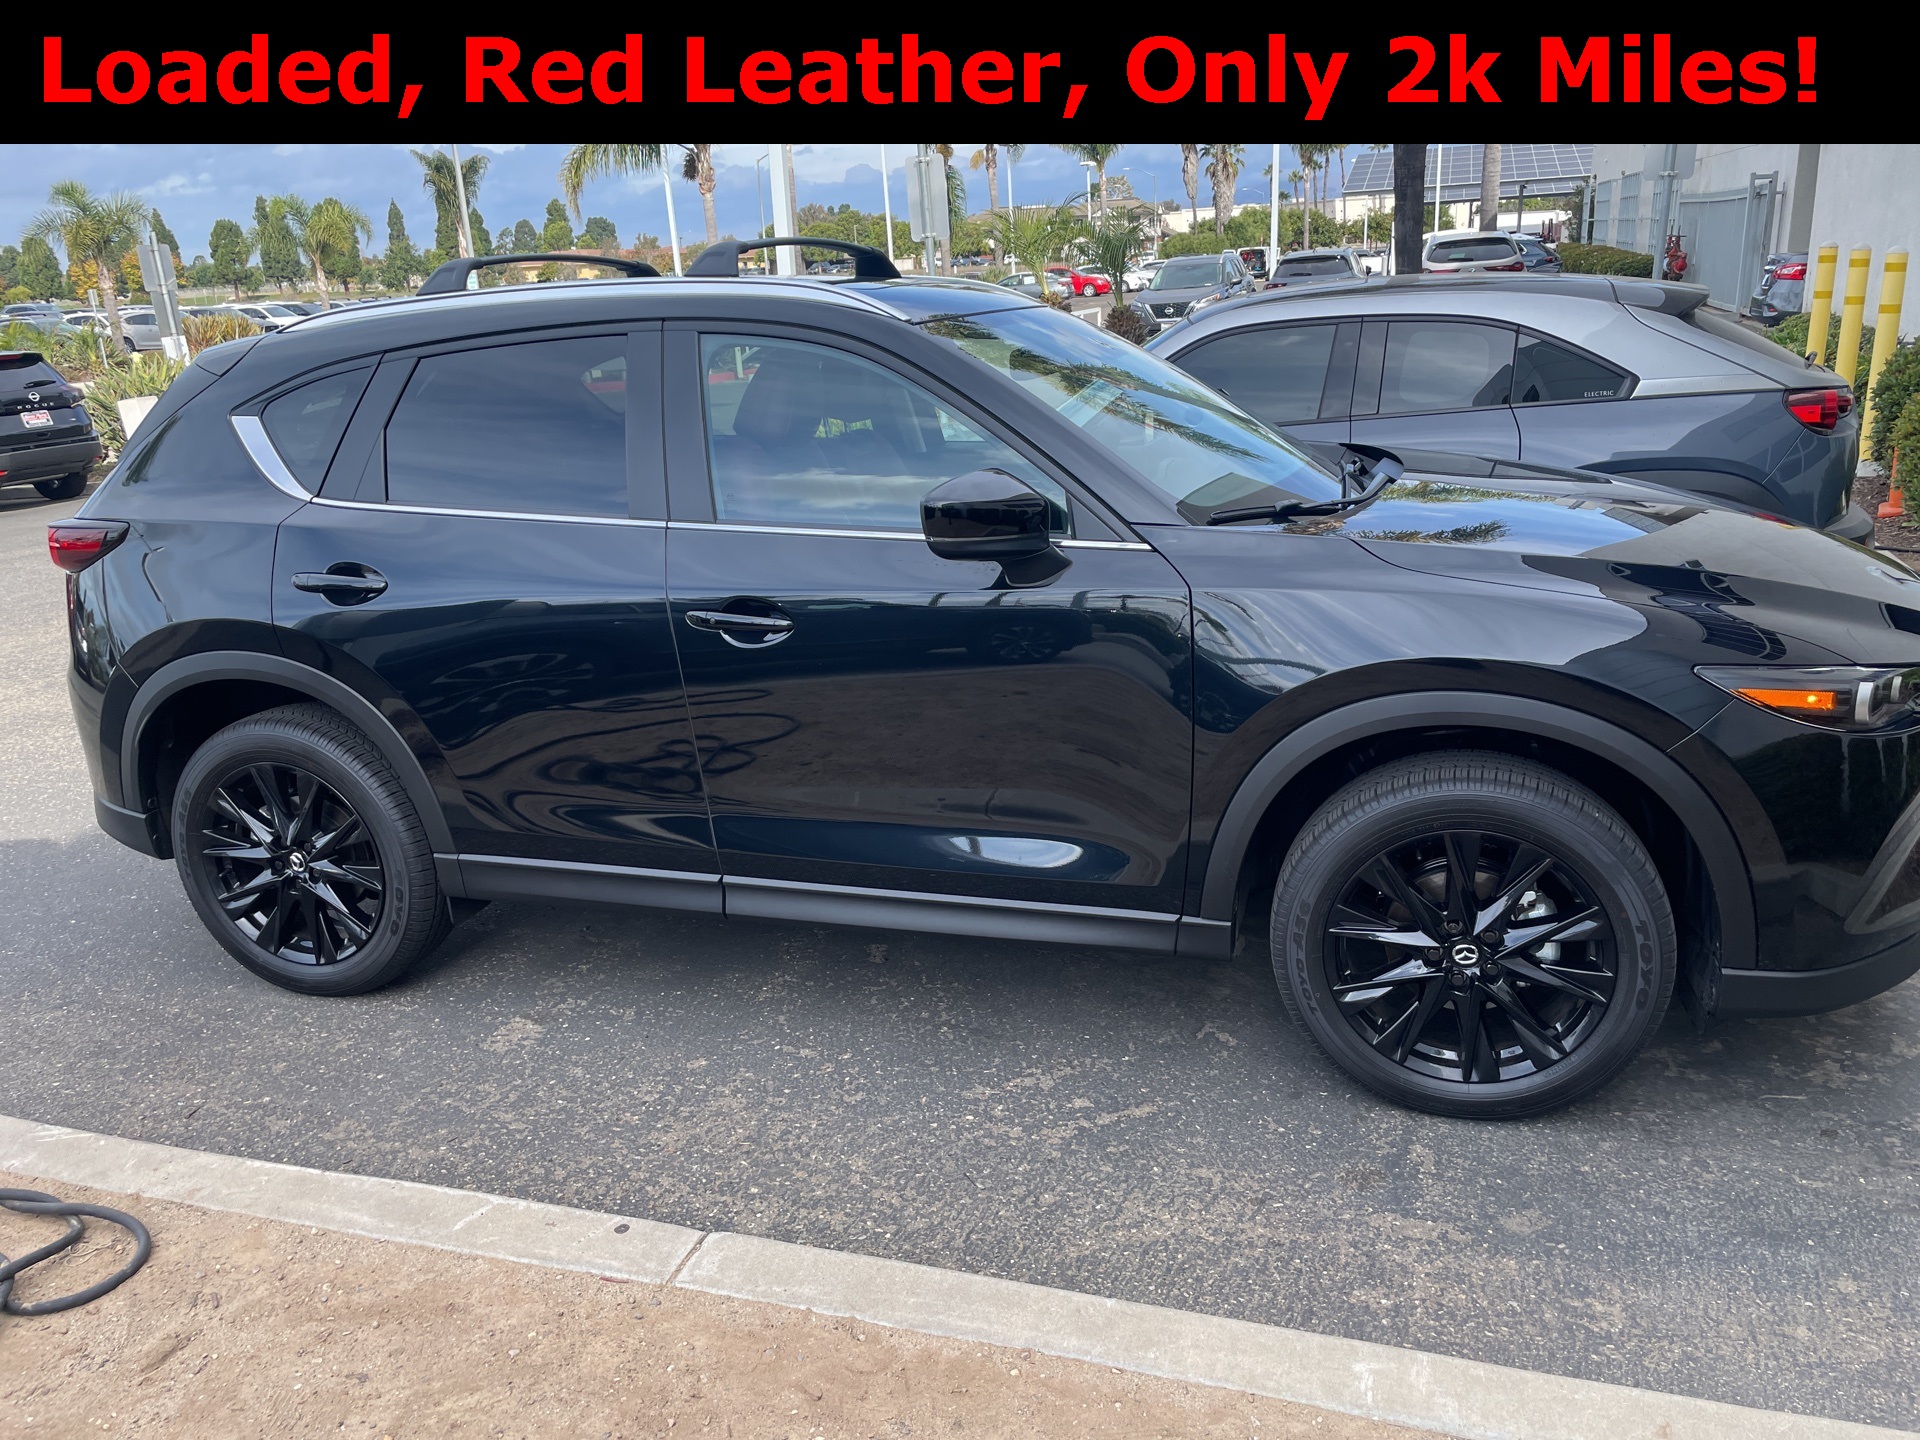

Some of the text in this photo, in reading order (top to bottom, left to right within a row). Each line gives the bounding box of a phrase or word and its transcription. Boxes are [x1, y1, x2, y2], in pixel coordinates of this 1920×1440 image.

[1584, 390, 1614, 398] ELECTRIC
[1295, 957, 1319, 1015] TOYO
[1632, 918, 1655, 1011] TOYO
